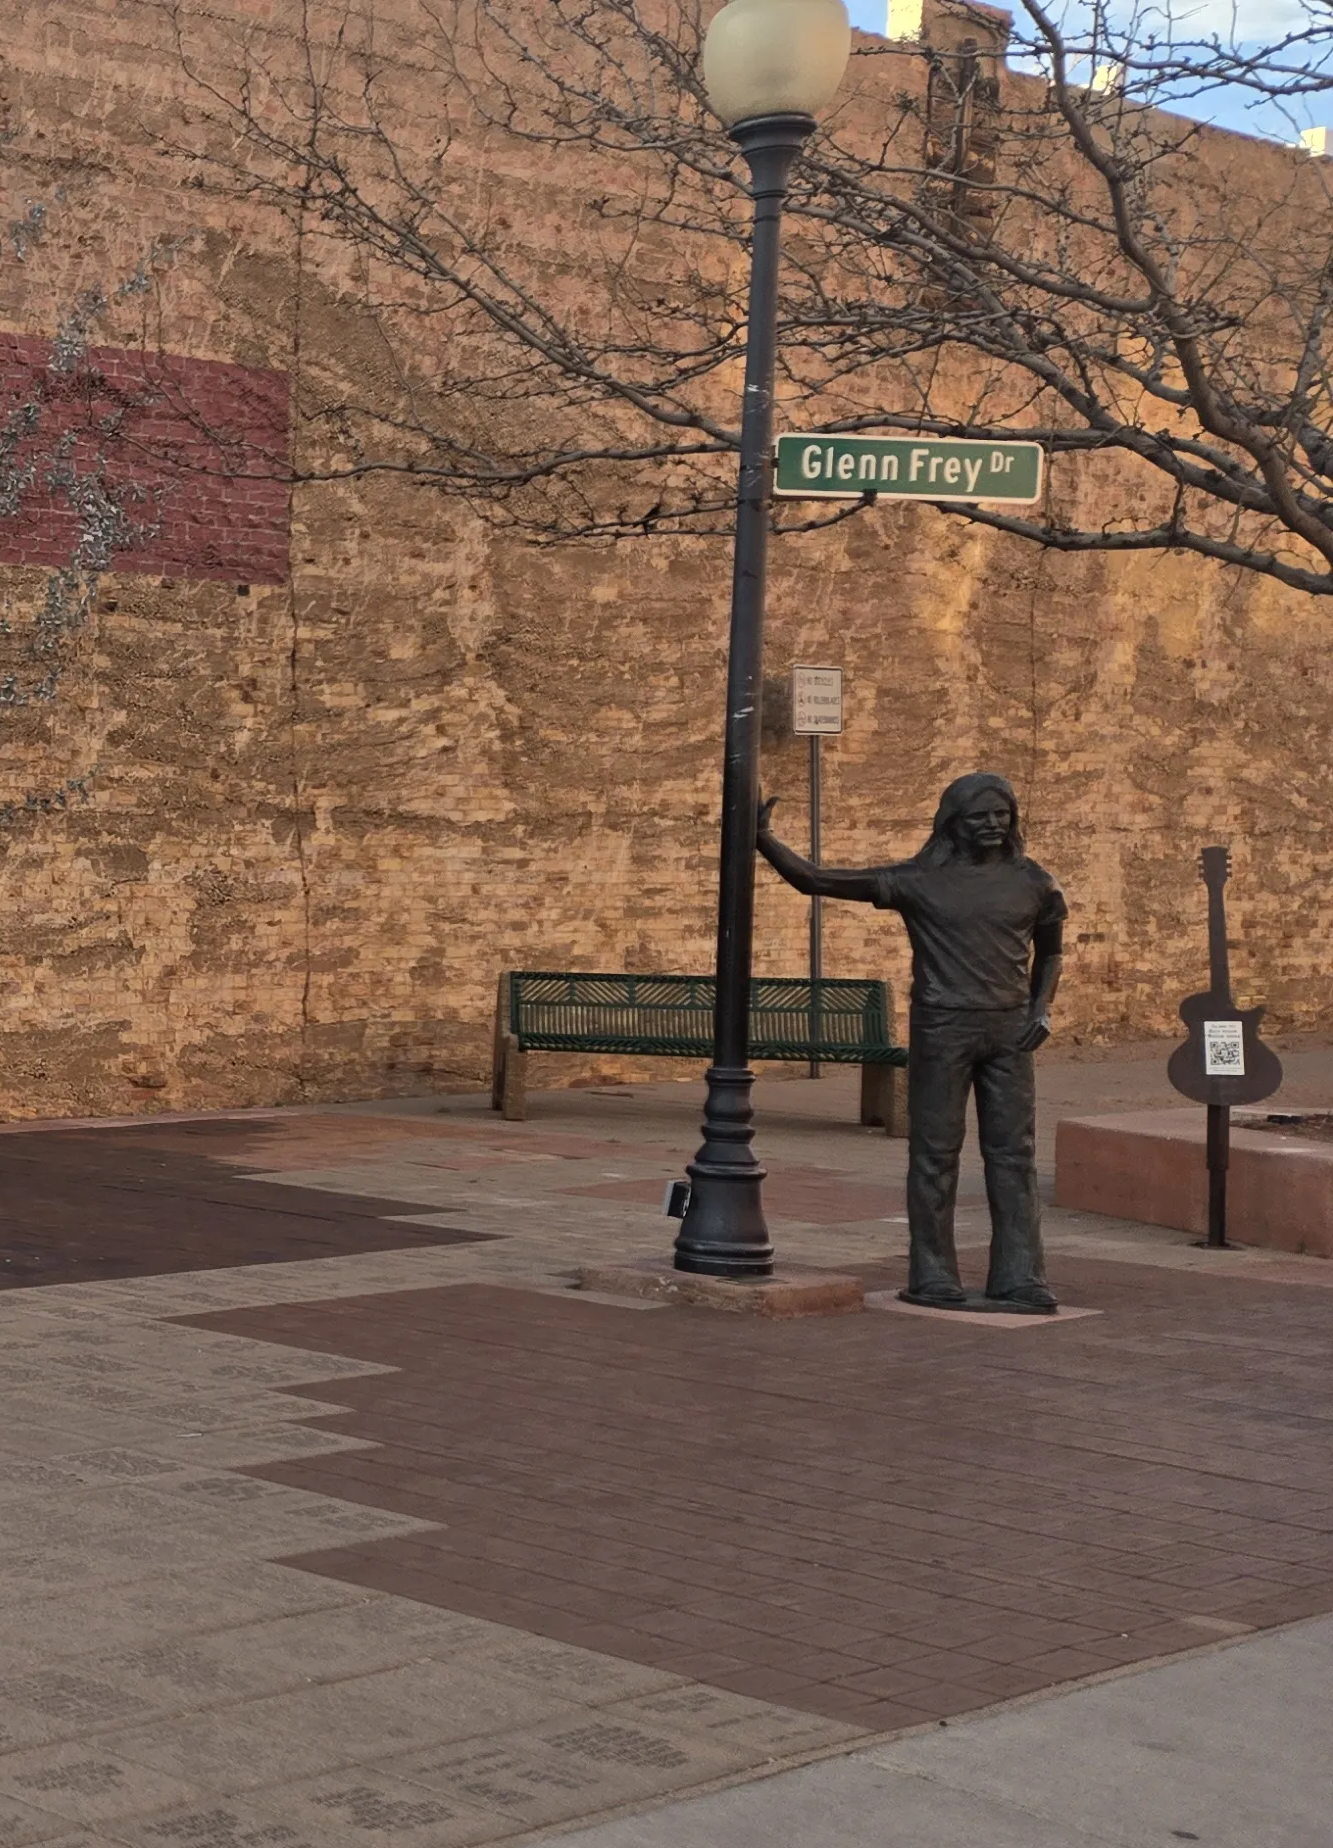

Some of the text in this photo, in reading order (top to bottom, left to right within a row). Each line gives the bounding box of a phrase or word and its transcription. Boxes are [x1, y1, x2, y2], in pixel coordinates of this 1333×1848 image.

[801, 444, 1016, 493] Glenn Frey Dr
